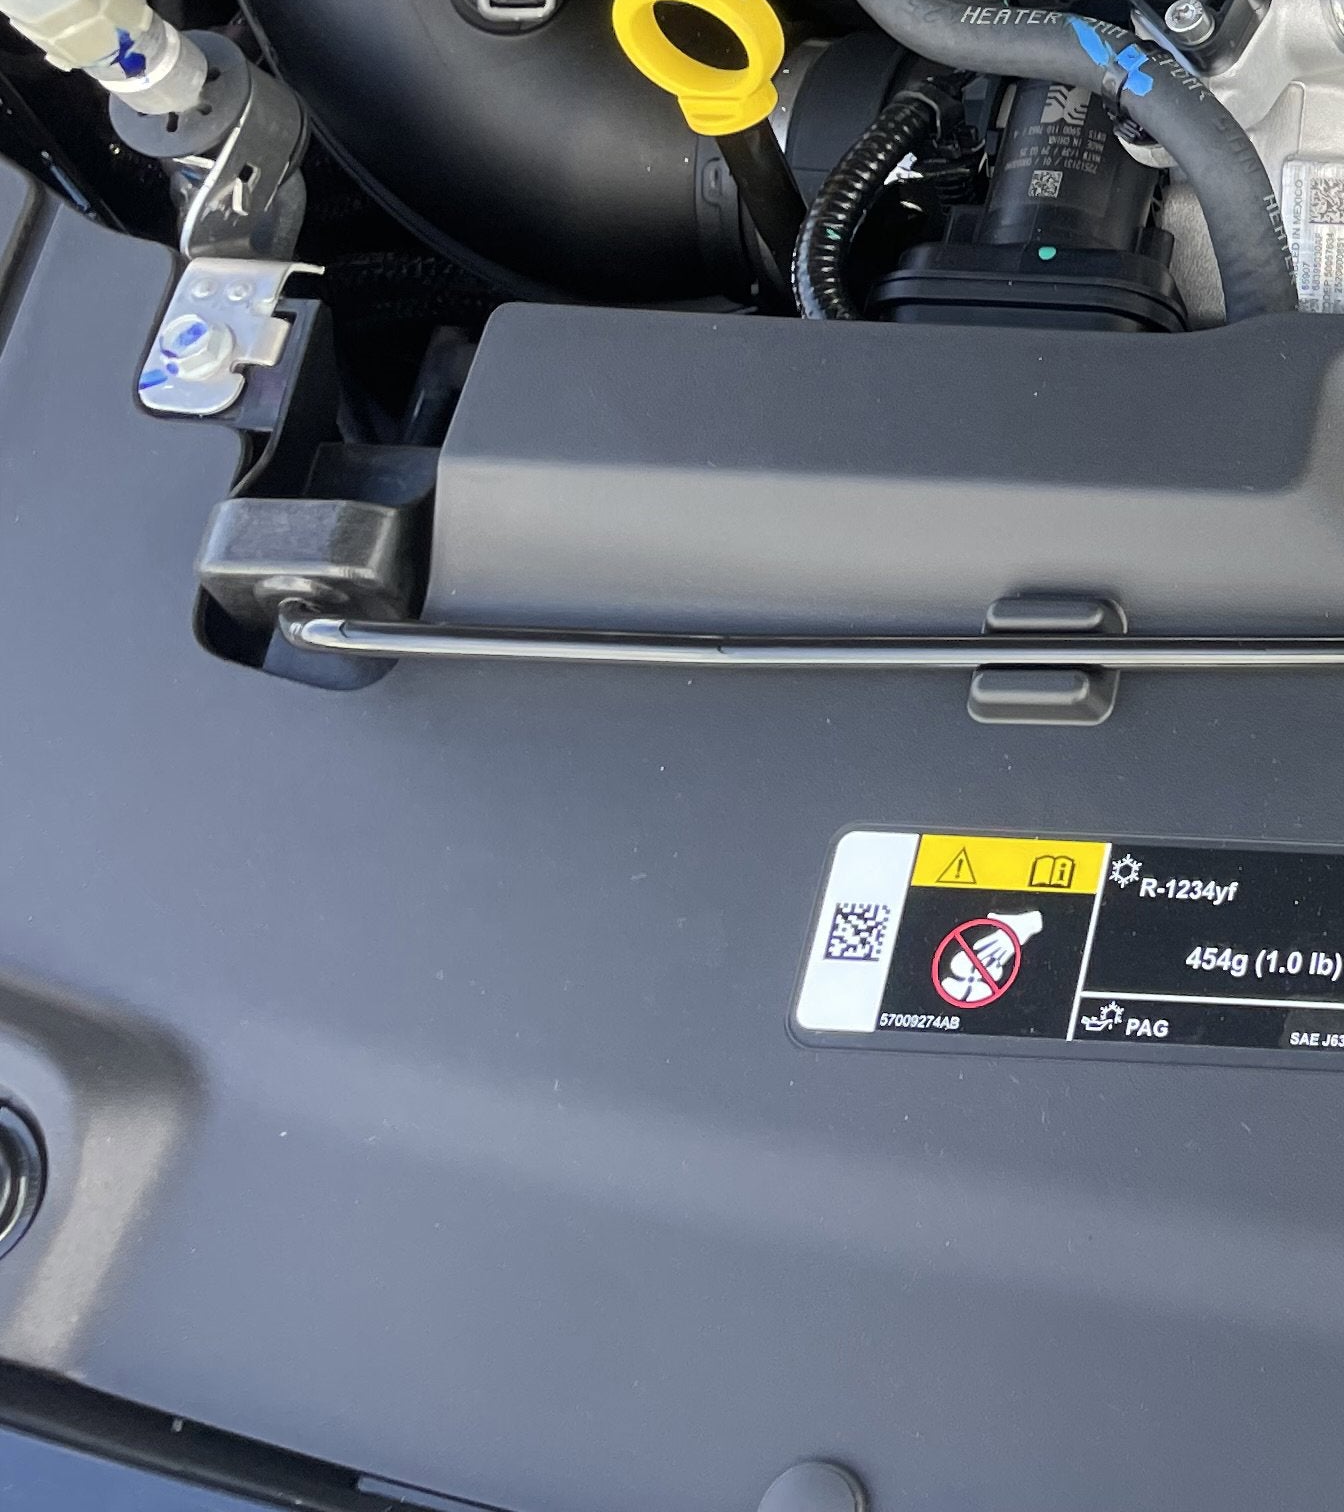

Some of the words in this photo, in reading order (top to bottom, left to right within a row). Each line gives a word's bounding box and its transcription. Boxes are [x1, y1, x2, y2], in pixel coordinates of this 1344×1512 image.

[960, 5, 1062, 26] HEATER
[1293, 179, 1303, 224] MEXICO
[1139, 877, 1237, 904] R-1234yf
[1185, 946, 1249, 979] 454g
[1253, 948, 1304, 978] (1.0
[1308, 952, 1343, 981] lb)
[878, 1013, 961, 1030] 57009274AB
[1124, 1018, 1170, 1040] PAG
[1289, 1031, 1319, 1048] SAE
